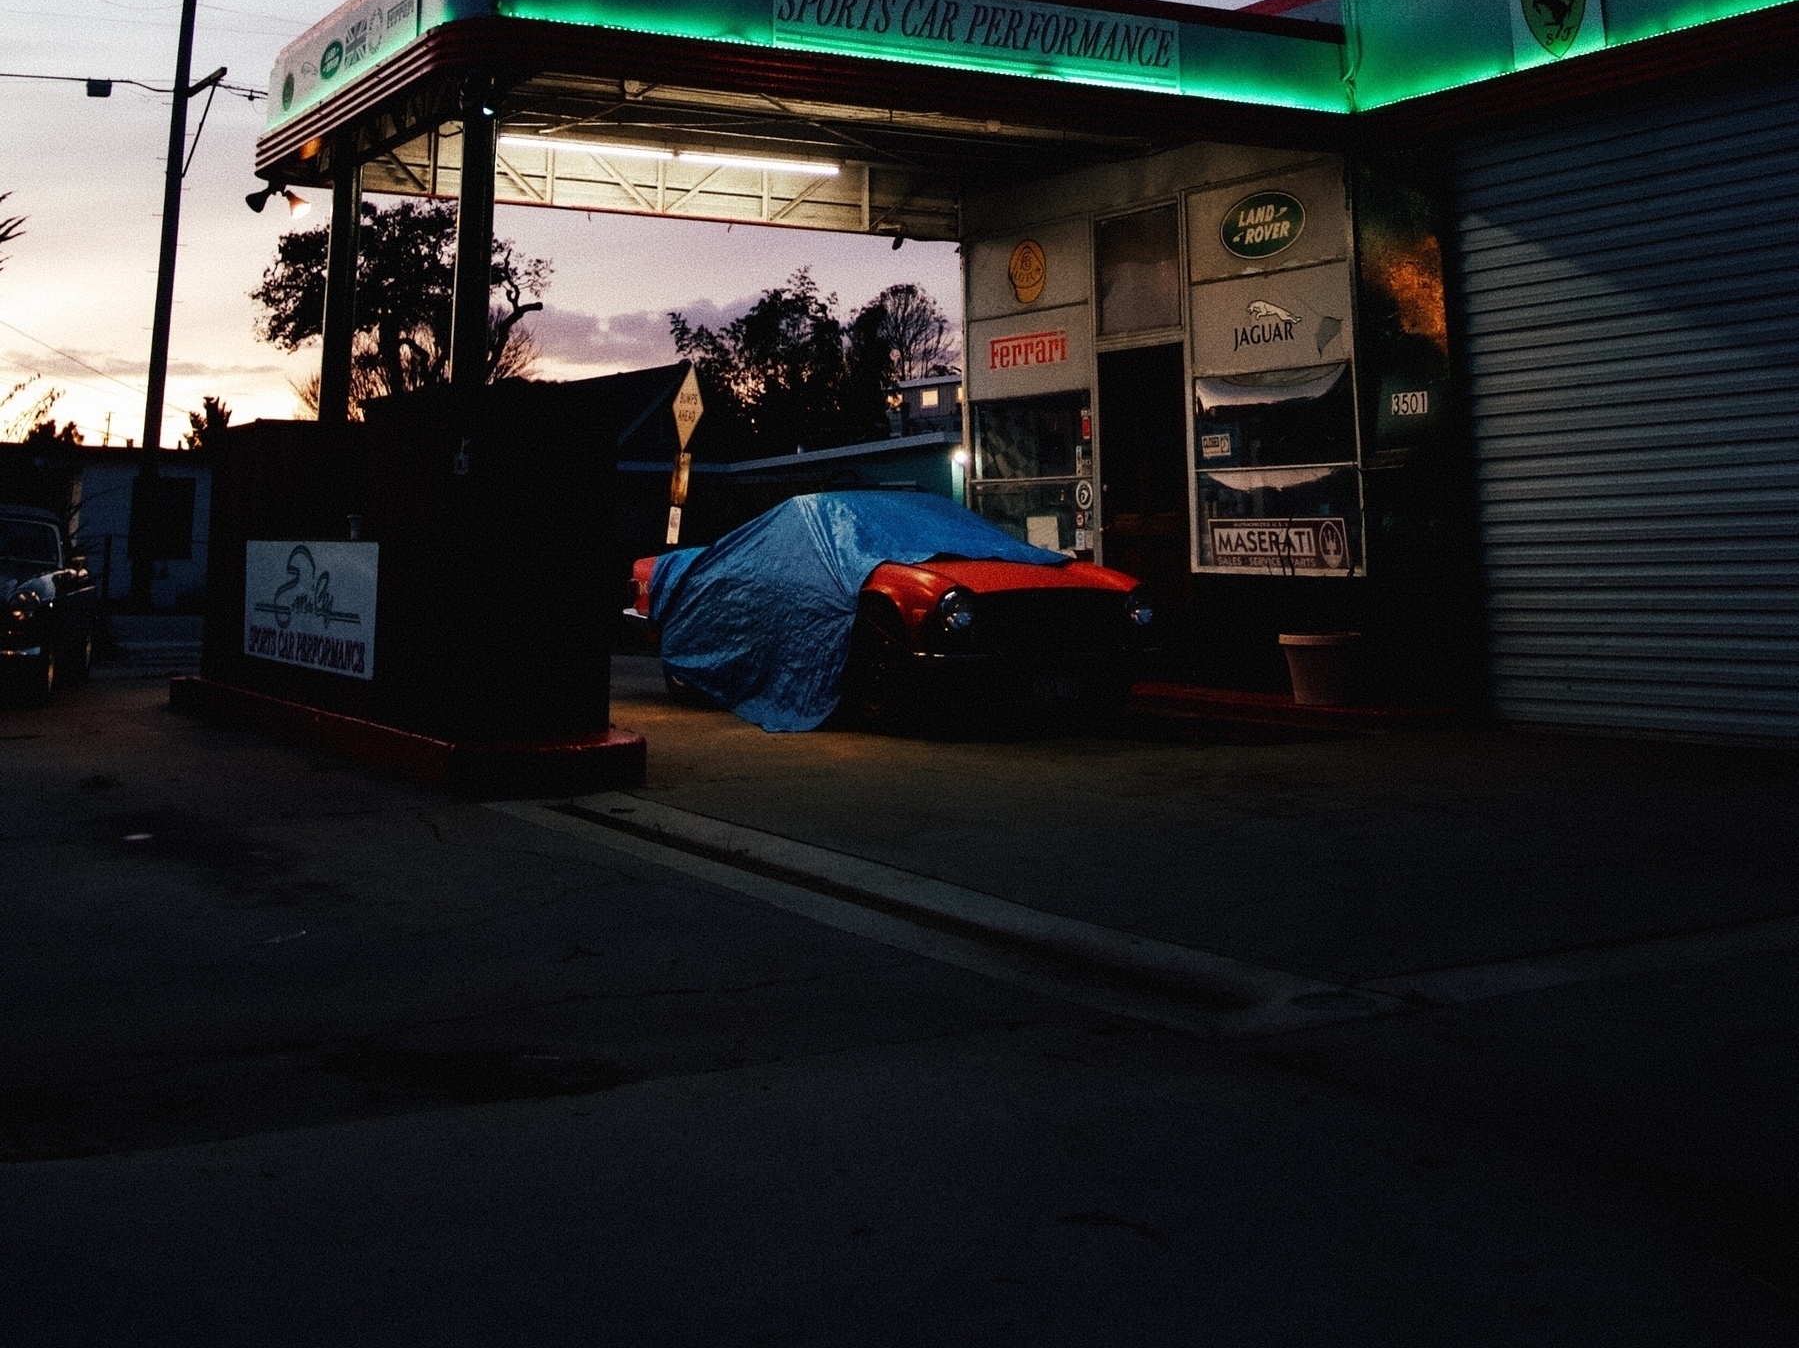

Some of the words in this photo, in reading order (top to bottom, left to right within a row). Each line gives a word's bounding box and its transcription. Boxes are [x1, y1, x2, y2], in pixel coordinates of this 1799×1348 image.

[964, 2, 1175, 68] PERFORMANCE
[1238, 204, 1275, 227] LAND
[1244, 221, 1291, 245] ROVER
[1234, 321, 1295, 351] JAGUAR
[989, 330, 1067, 370] Ferrari
[1393, 392, 1426, 415] 3501
[678, 409, 696, 422] AHEAD
[1218, 531, 1313, 554] MASERATI
[1218, 555, 1243, 567] SALES
[1248, 556, 1282, 568] SERVICE
[248, 626, 276, 656] SPORTS
[278, 630, 295, 659] CAR
[297, 633, 366, 673] PERFORMANCE
